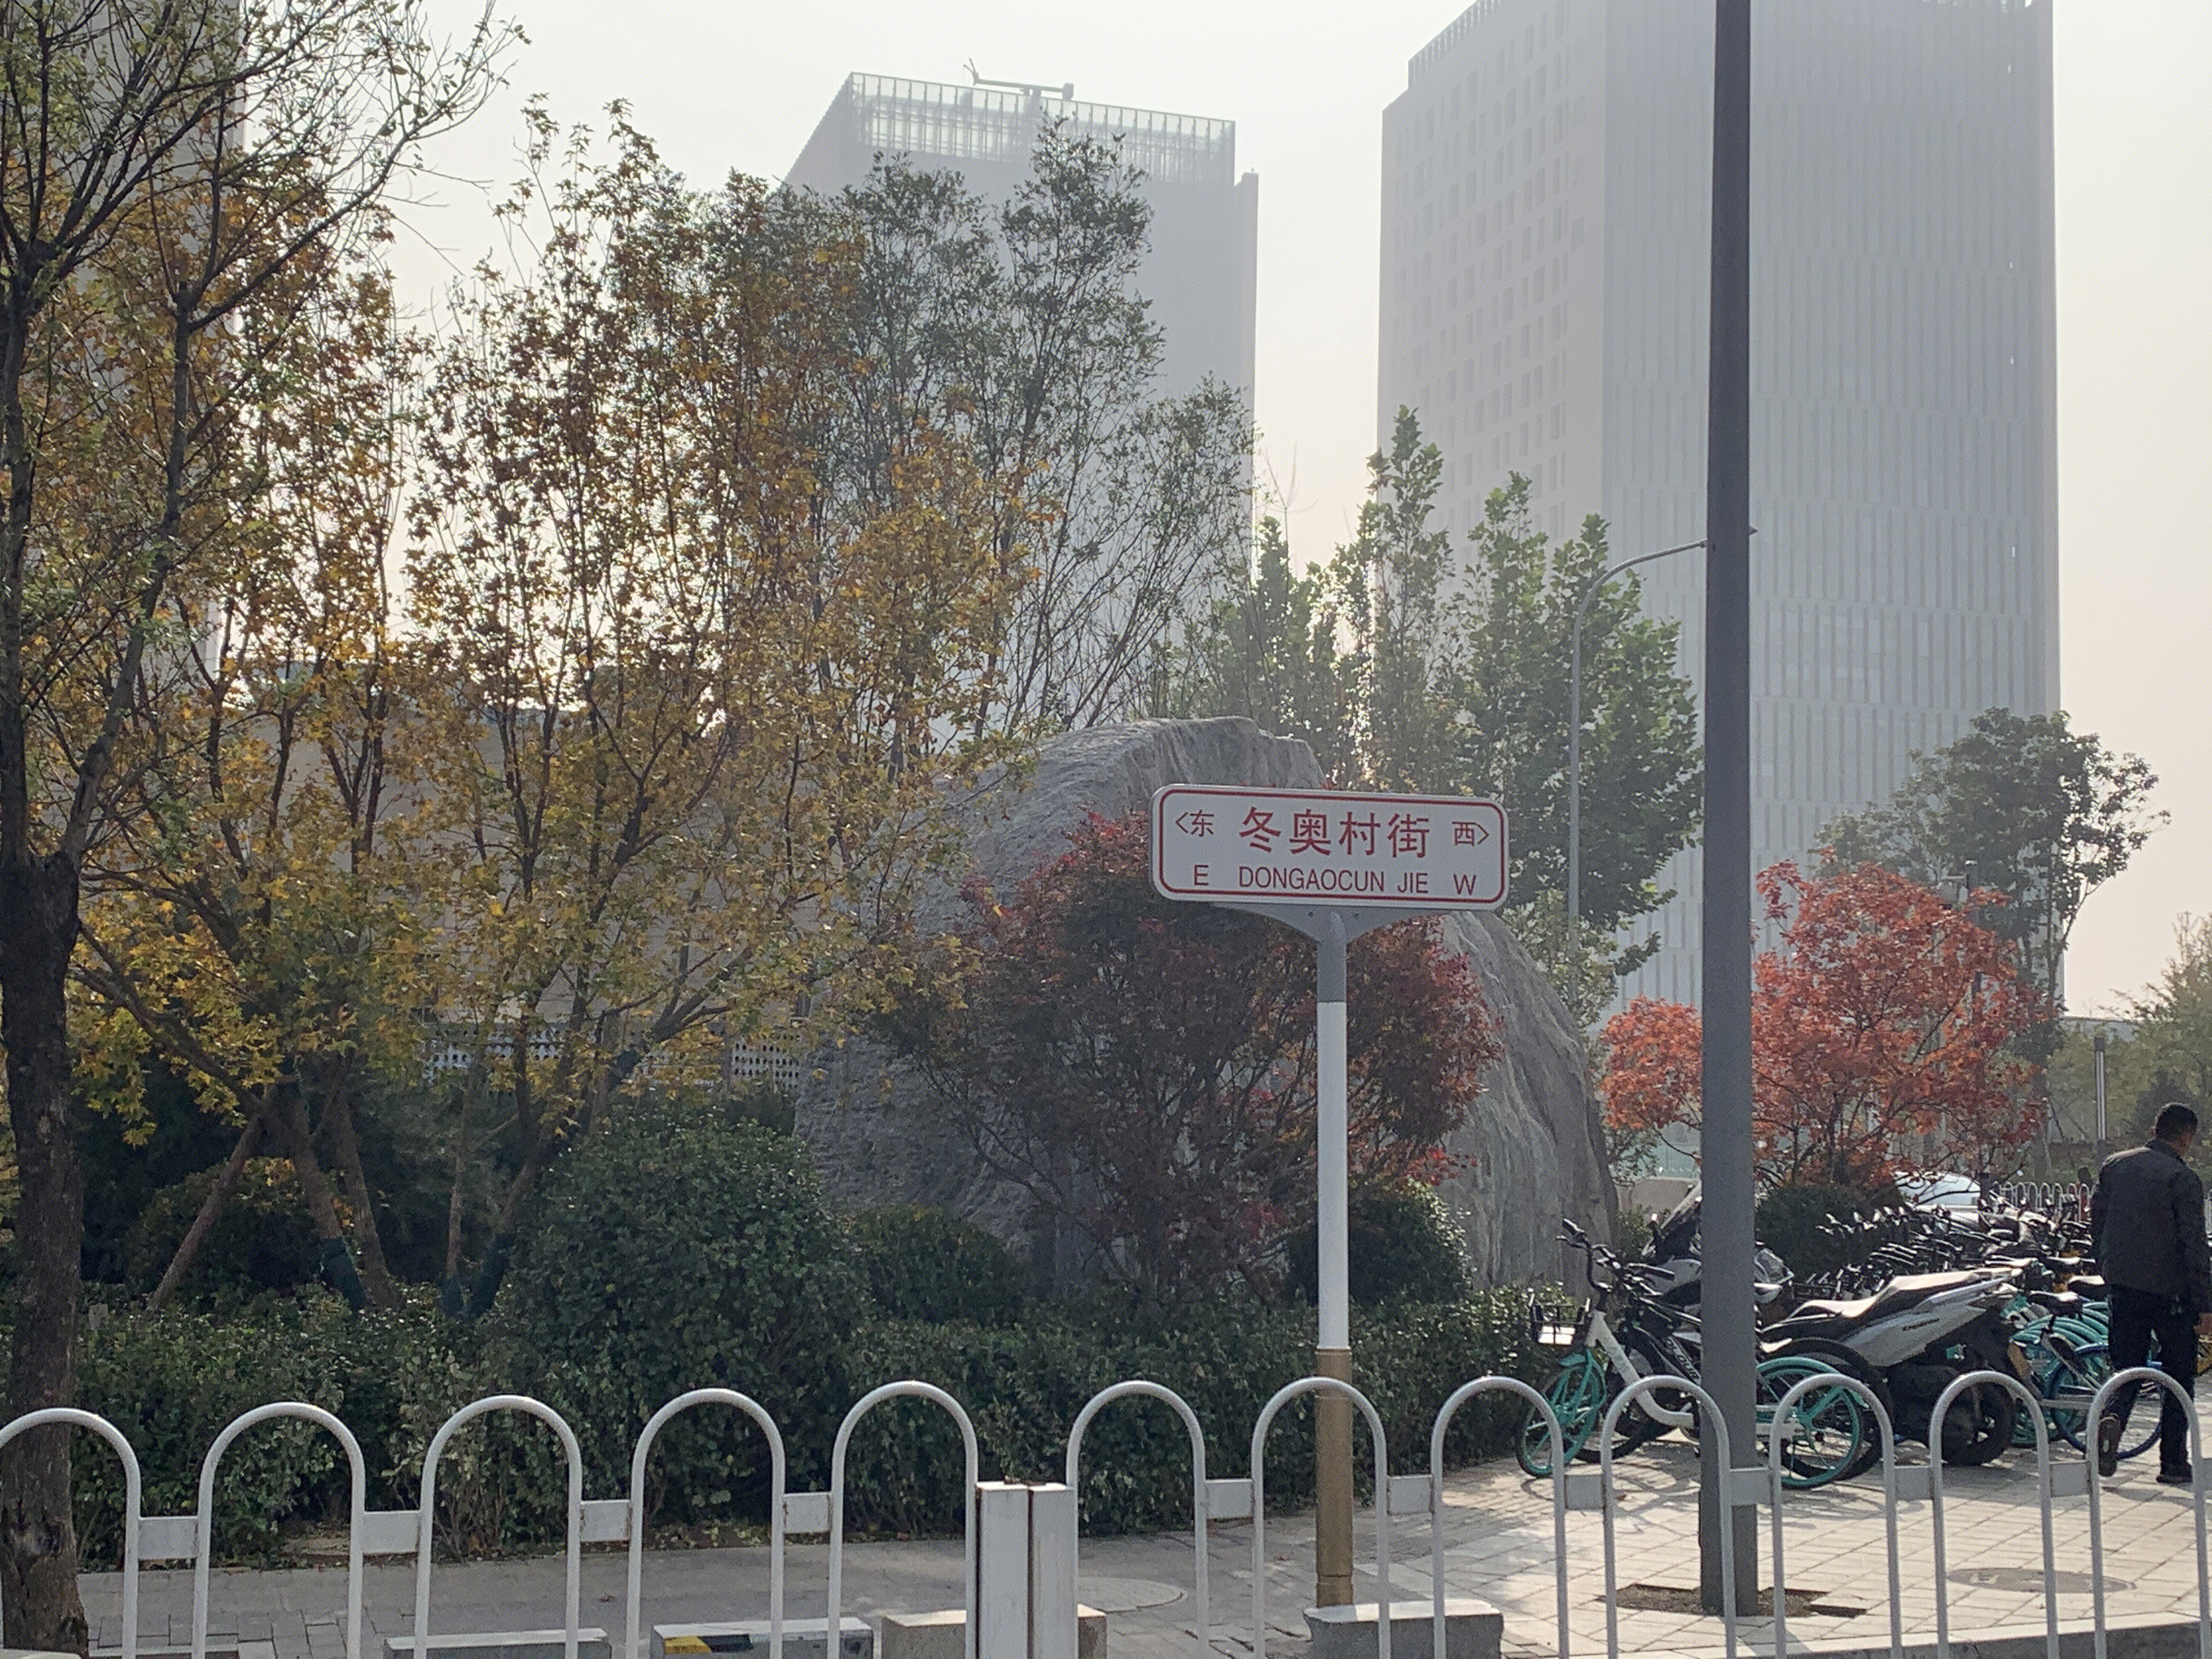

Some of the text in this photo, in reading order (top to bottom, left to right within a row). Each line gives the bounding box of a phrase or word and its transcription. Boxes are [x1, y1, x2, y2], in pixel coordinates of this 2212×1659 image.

[1189, 806, 1476, 858] 东 冬奥村街 西
[1193, 864, 1477, 896] E DONGAOCUN JIE W
